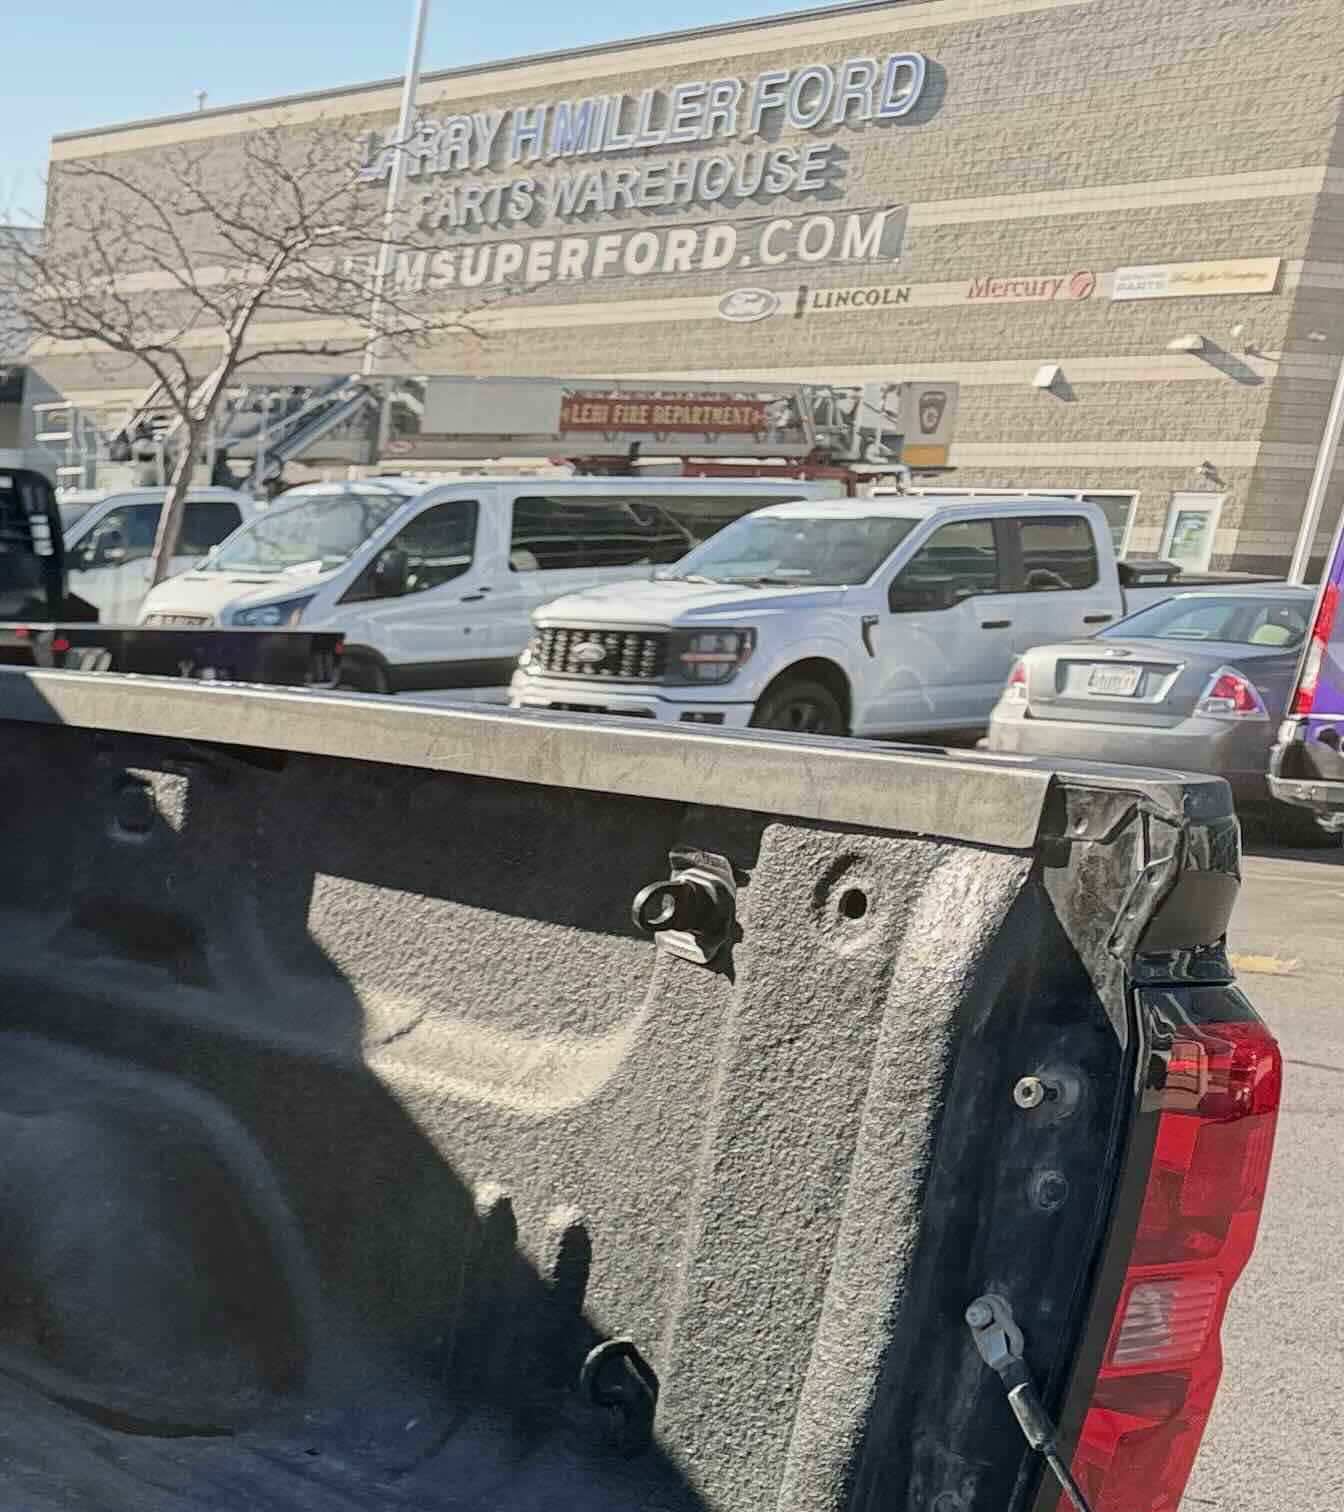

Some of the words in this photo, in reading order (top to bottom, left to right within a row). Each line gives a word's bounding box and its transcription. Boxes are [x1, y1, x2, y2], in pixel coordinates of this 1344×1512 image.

[512, 104, 546, 164] H
[545, 78, 743, 161] MILLER
[749, 52, 926, 136] FORD
[538, 143, 833, 219] WAREHOUSE
[812, 285, 912, 309] LINCOLN
[967, 277, 1065, 299] Mercury
[613, 404, 651, 424] FIRE
[653, 404, 753, 425] DEPARTMENT
